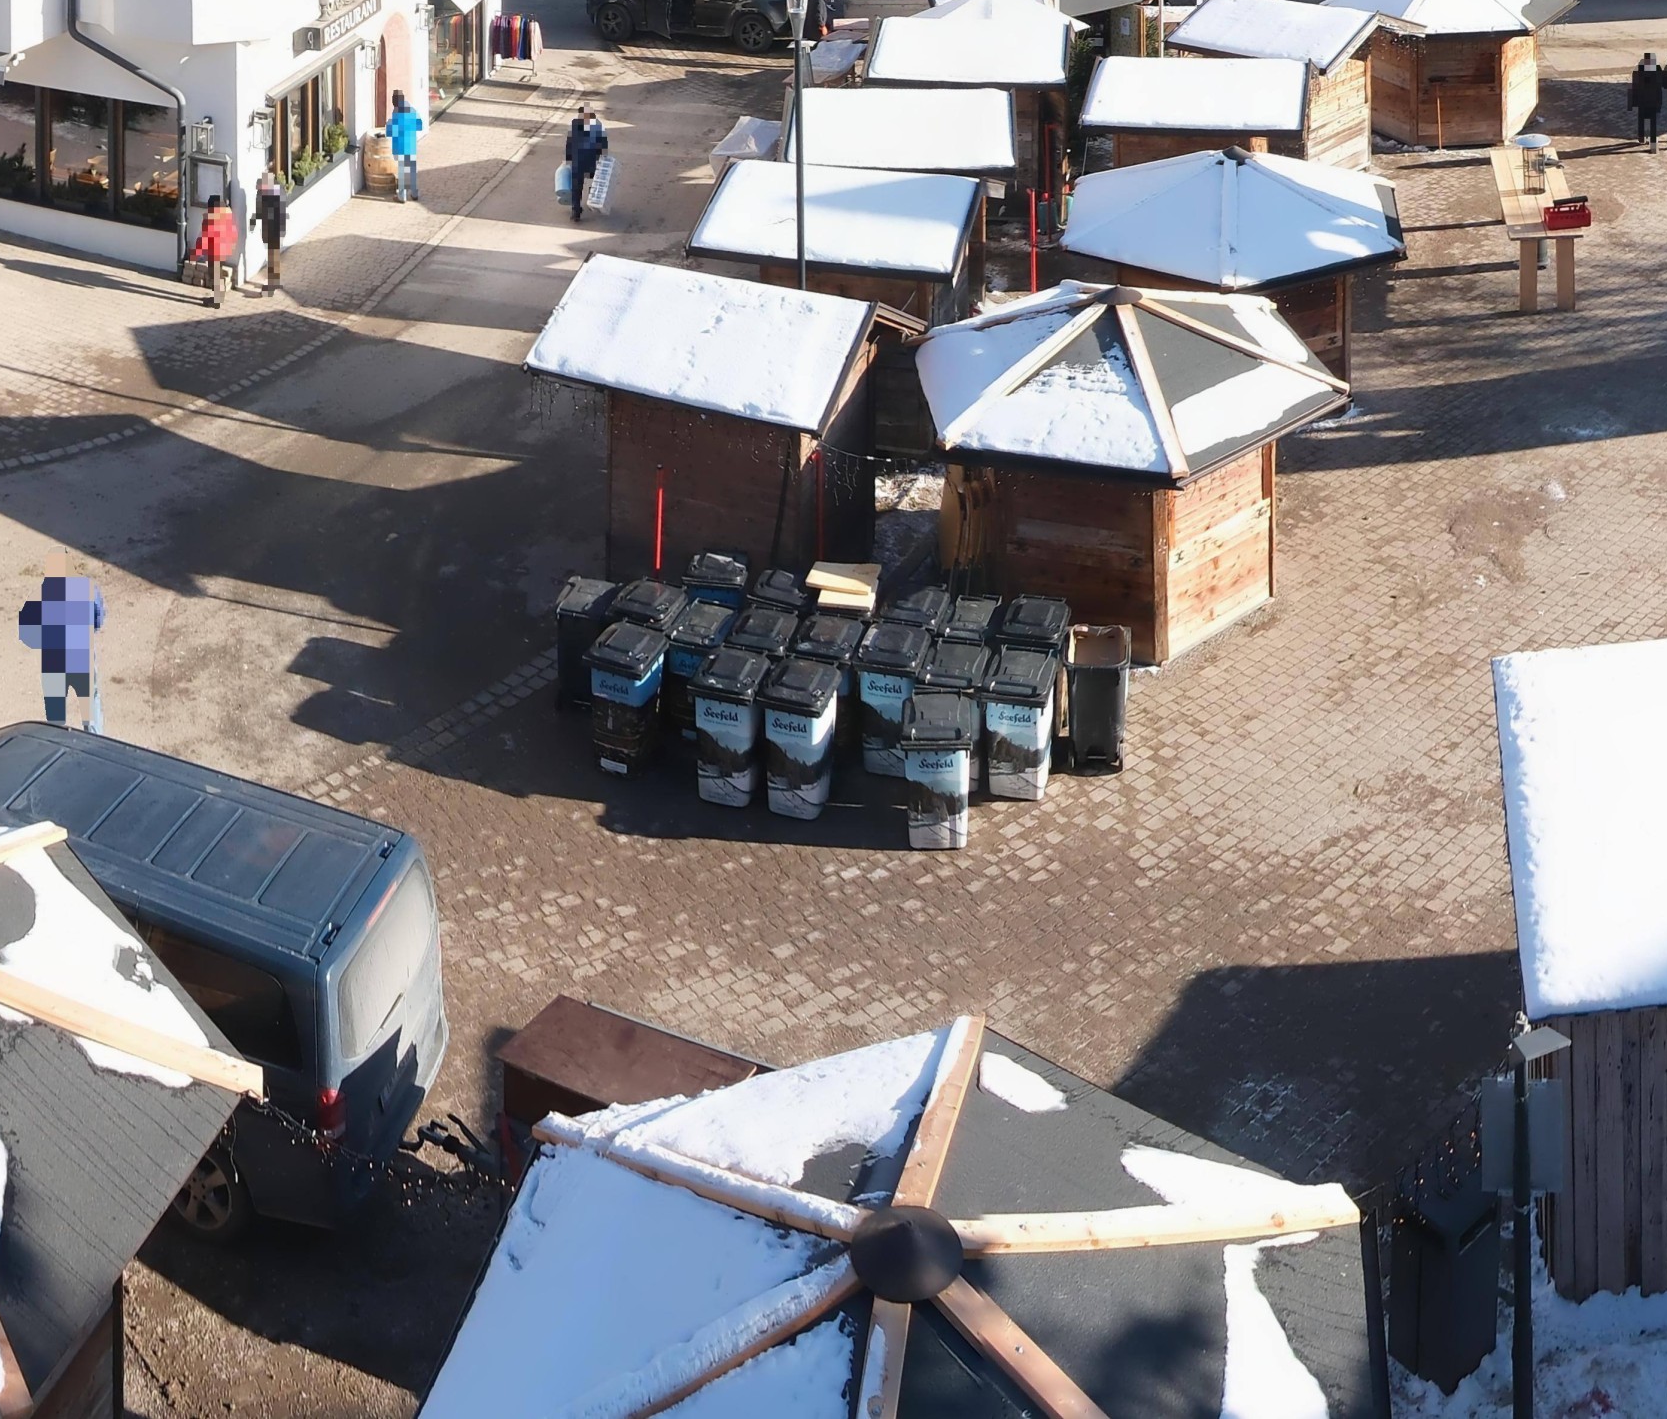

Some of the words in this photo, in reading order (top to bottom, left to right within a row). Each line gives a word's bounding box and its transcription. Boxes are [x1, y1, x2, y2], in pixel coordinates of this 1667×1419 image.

[599, 680, 630, 696] Seefeld
[867, 680, 903, 695] Seefeld
[703, 706, 739, 723] Seefeld
[997, 710, 1032, 724] Seefeld
[771, 717, 808, 734] Seefeld
[918, 757, 954, 771] Seefeld
